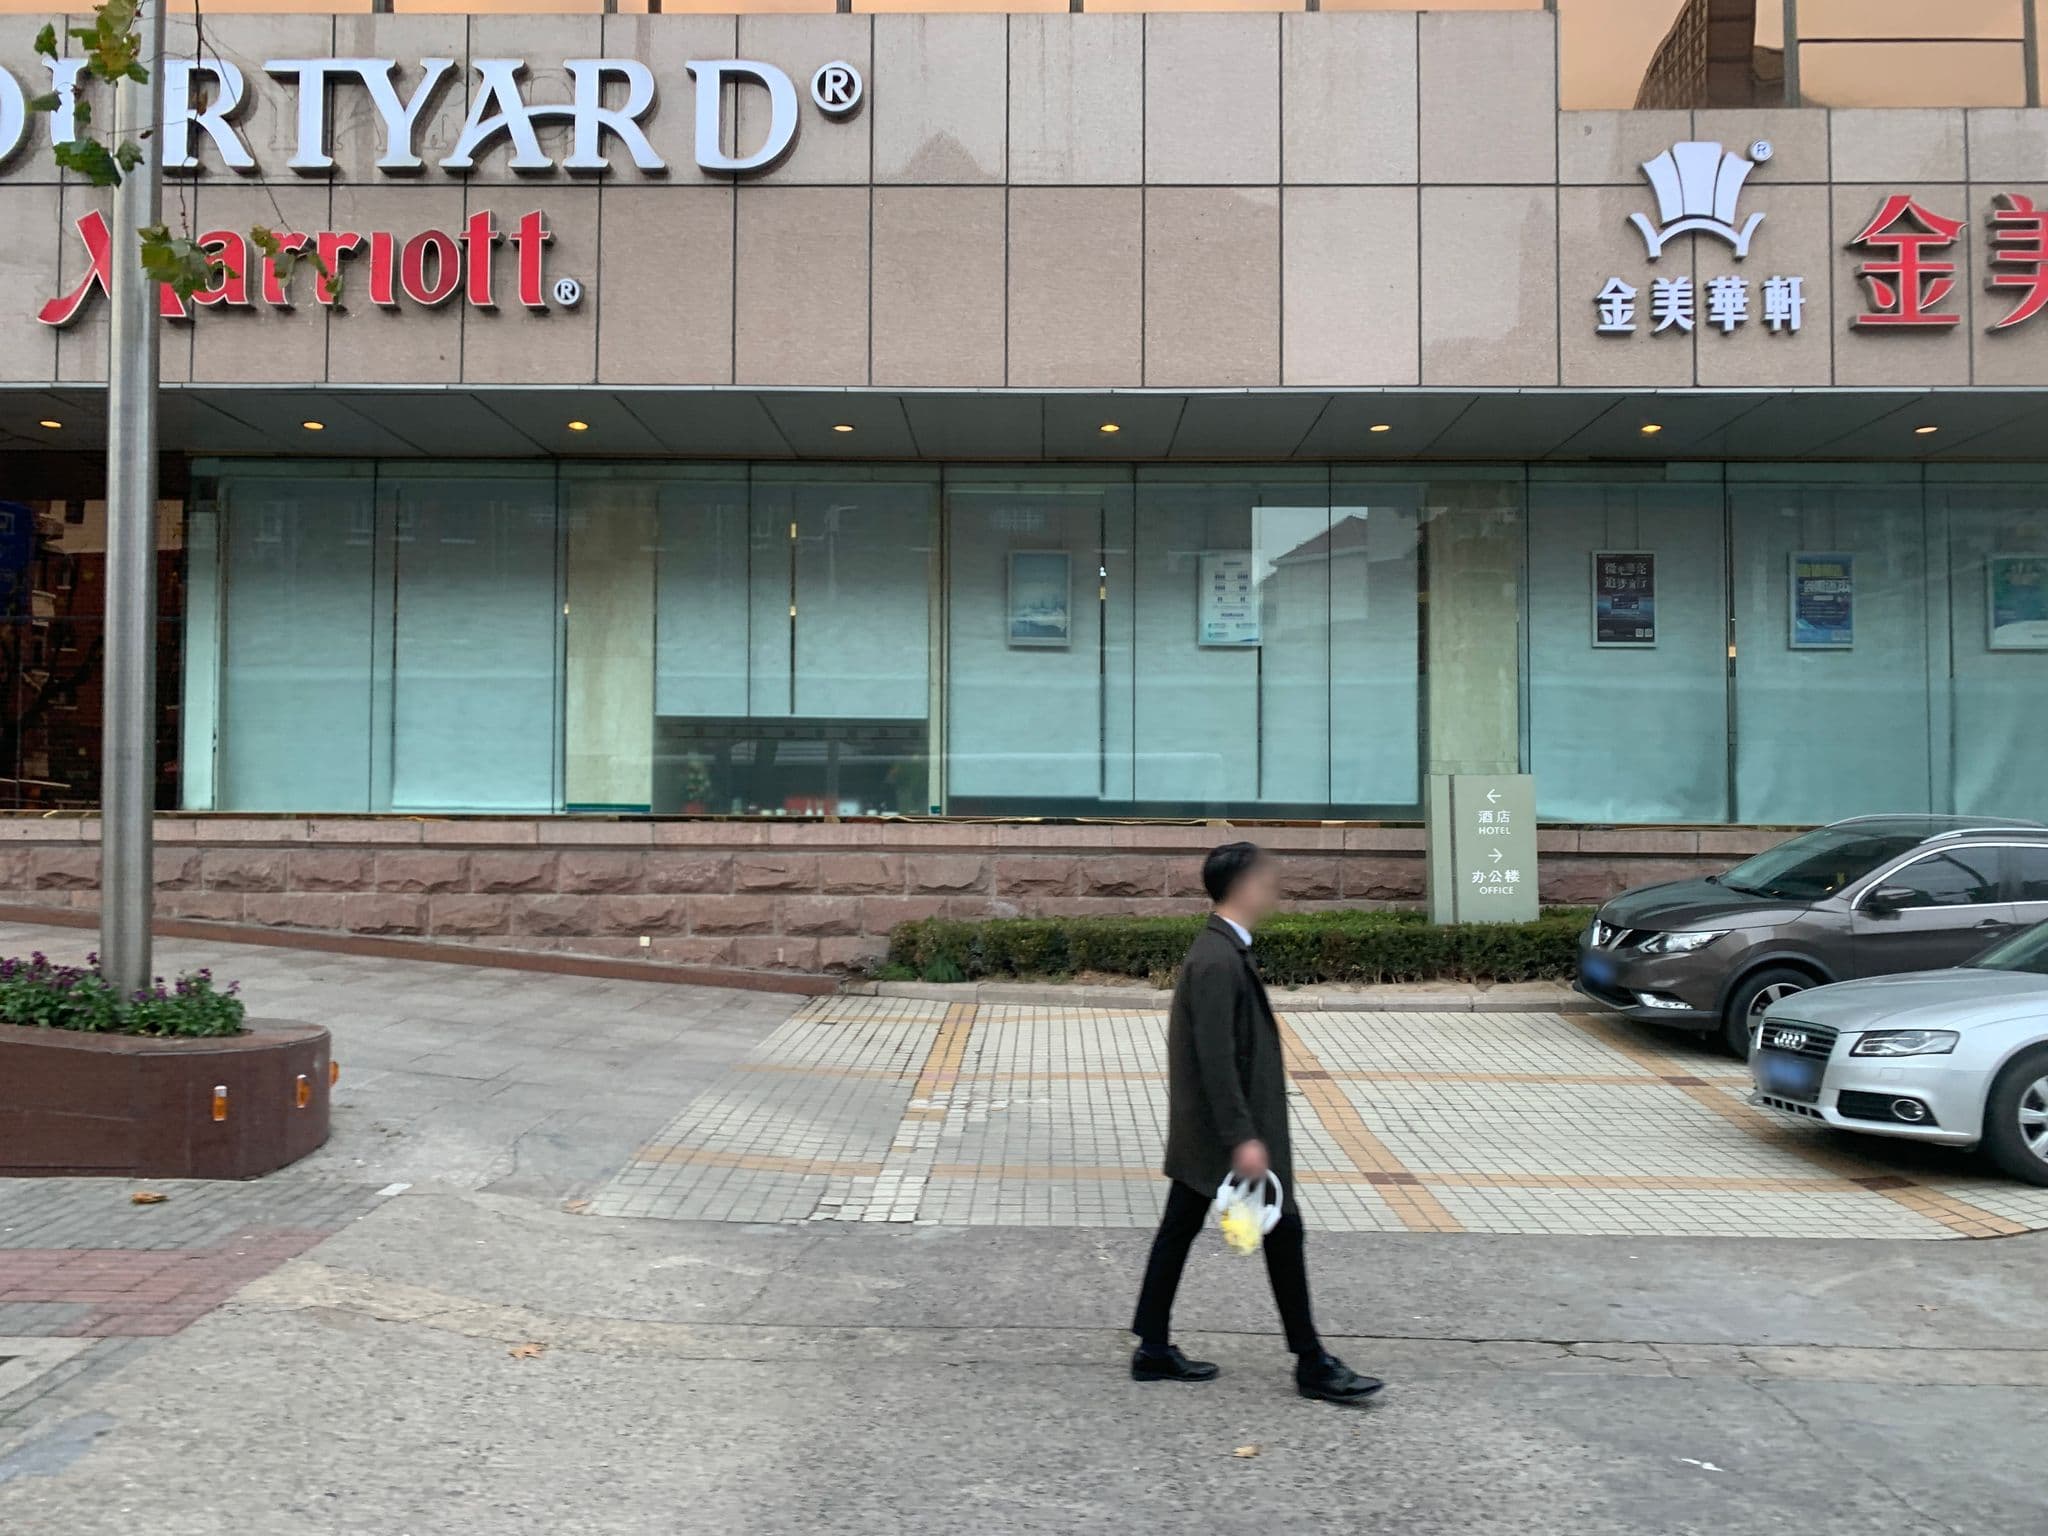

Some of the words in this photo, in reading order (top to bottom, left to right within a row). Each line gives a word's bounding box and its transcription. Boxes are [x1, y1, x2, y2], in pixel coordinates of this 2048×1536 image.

[1594, 275, 1807, 332] 金美華軒
[1478, 810, 1512, 824] 酒店
[1478, 826, 1512, 835] HOTEL
[1472, 869, 1521, 884] 办公楼
[1479, 886, 1515, 895] OFFICE
